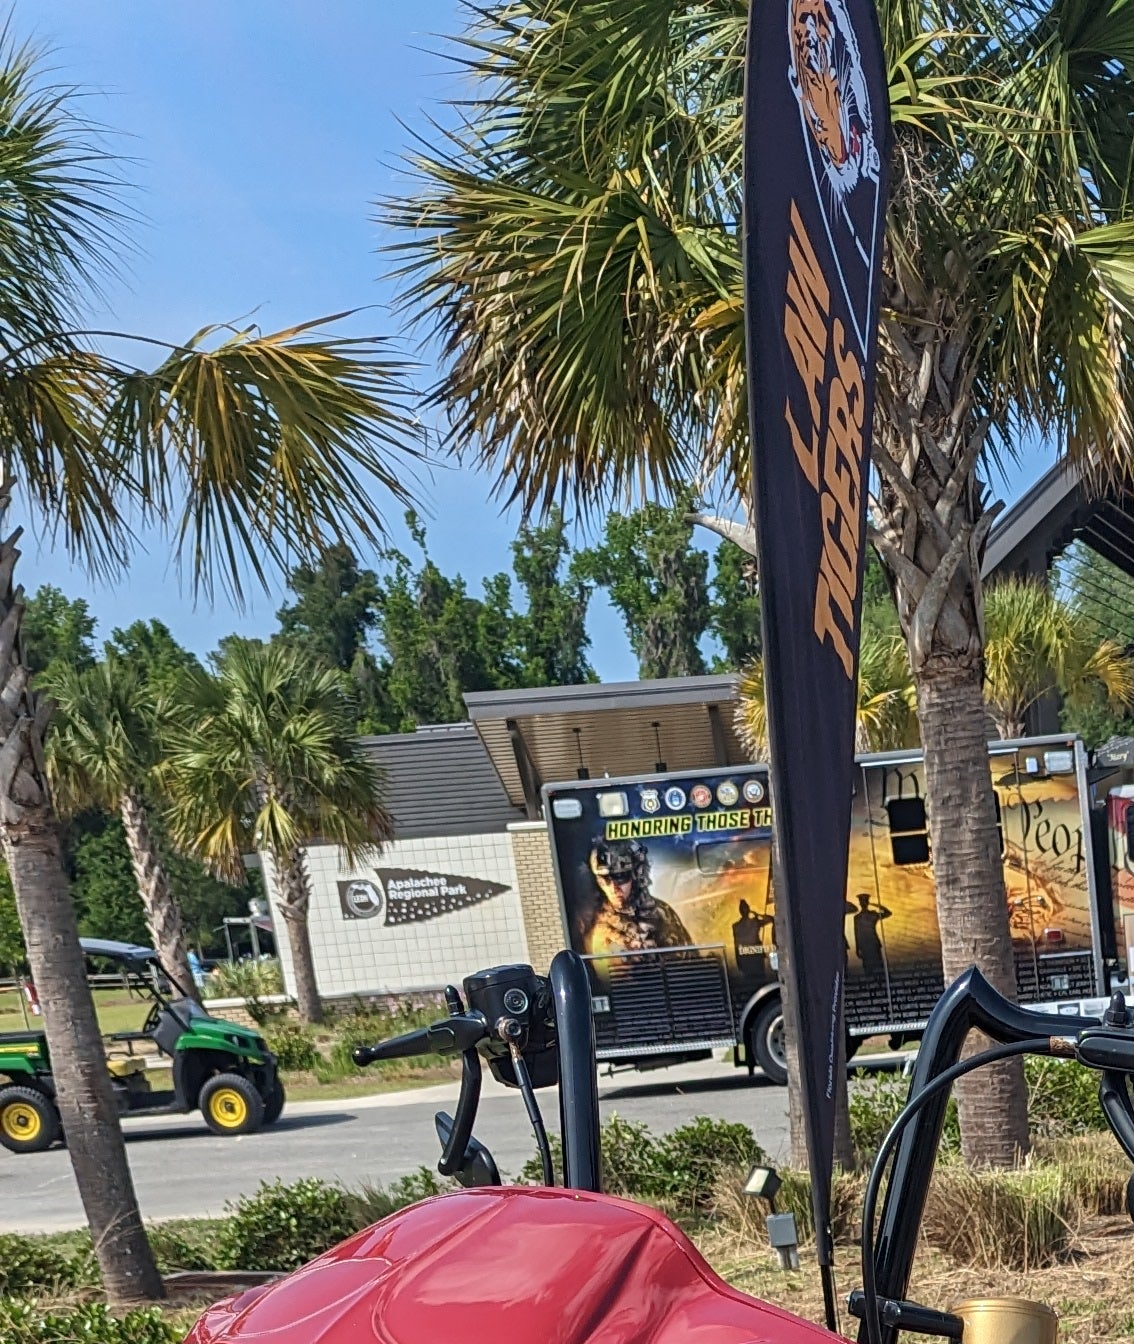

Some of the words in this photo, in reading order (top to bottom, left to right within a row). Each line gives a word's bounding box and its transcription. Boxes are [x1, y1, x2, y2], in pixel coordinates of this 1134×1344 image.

[783, 198, 830, 493] LAW
[814, 318, 865, 680] TIGERS
[606, 815, 693, 841] HONORING
[695, 809, 751, 832] THOSE
[387, 876, 447, 891] Apalachee
[387, 886, 439, 900] Regional
[440, 884, 468, 896] Park
